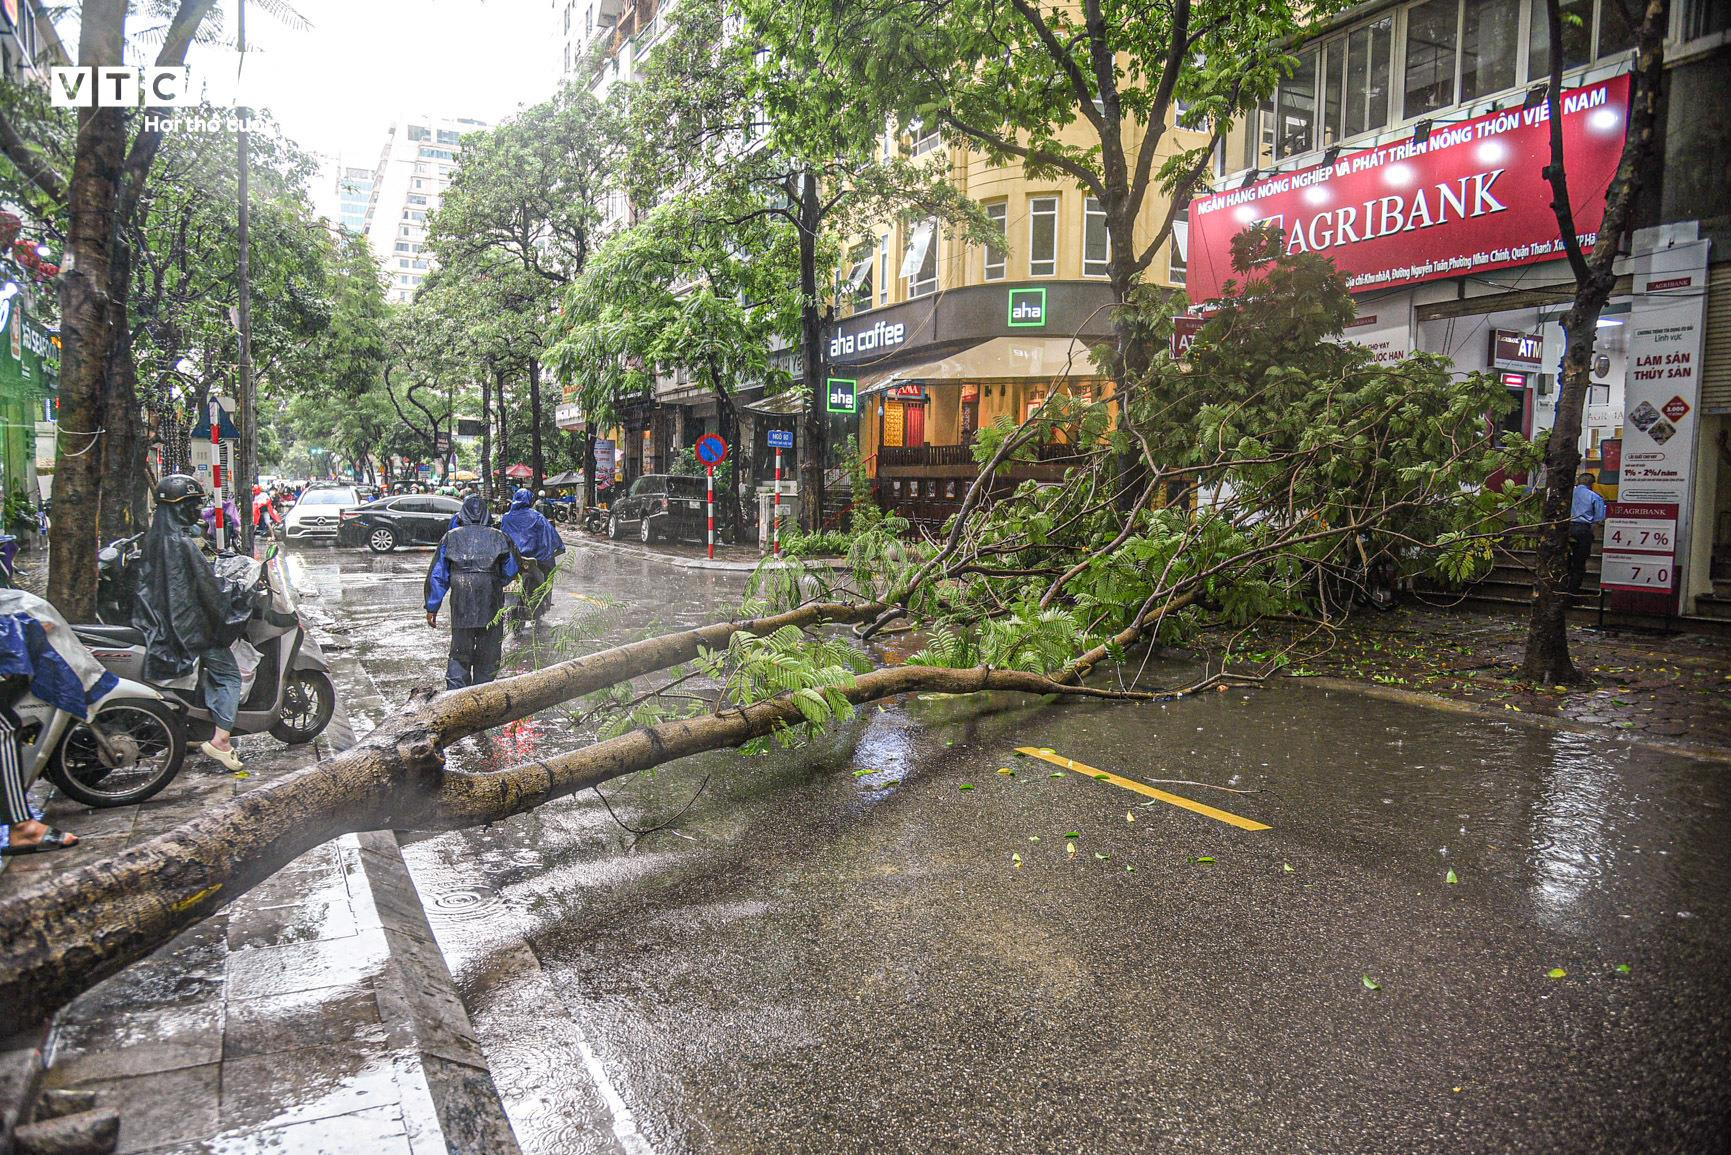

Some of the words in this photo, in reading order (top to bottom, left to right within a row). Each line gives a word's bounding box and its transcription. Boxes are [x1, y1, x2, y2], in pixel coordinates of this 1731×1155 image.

[1198, 194, 1225, 215] NGÂN
[1227, 187, 1256, 207] HÀNG
[1258, 178, 1289, 199] NÔNG
[1335, 157, 1351, 178] VÀ
[1352, 147, 1387, 173] PHÁT
[1429, 126, 1472, 152] NÔNG
[1476, 112, 1520, 139] THÔN
[1523, 100, 1550, 128] VIỆ
[1563, 86, 1608, 115] NAM
[1285, 168, 1508, 257] AGRIBANK
[1012, 301, 1041, 319] aha
[830, 326, 854, 358] aha
[857, 320, 904, 352] coffee
[1517, 337, 1542, 359] ATM
[1665, 350, 1691, 365] SẢN
[1667, 364, 1692, 379] SẢN
[830, 387, 854, 405] aha
[1623, 507, 1667, 516] AGRIBANK
